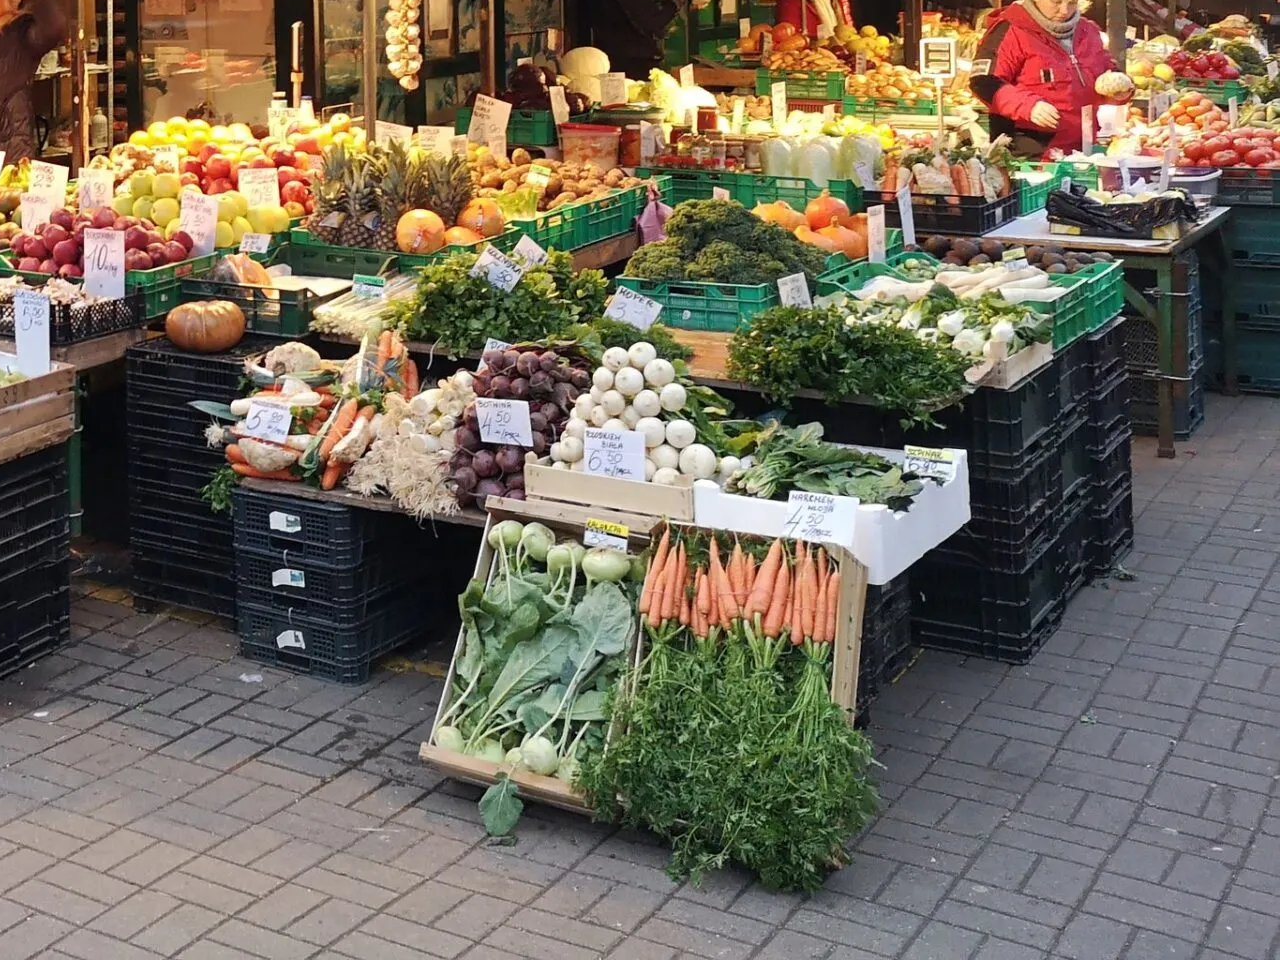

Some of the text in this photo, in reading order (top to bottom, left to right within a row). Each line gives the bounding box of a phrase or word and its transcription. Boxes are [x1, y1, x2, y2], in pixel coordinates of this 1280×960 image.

[619, 287, 655, 308] KOPER
[246, 409, 269, 431] 5
[481, 411, 493, 437] 4
[588, 449, 602, 472] 6
[786, 505, 803, 538] 4
